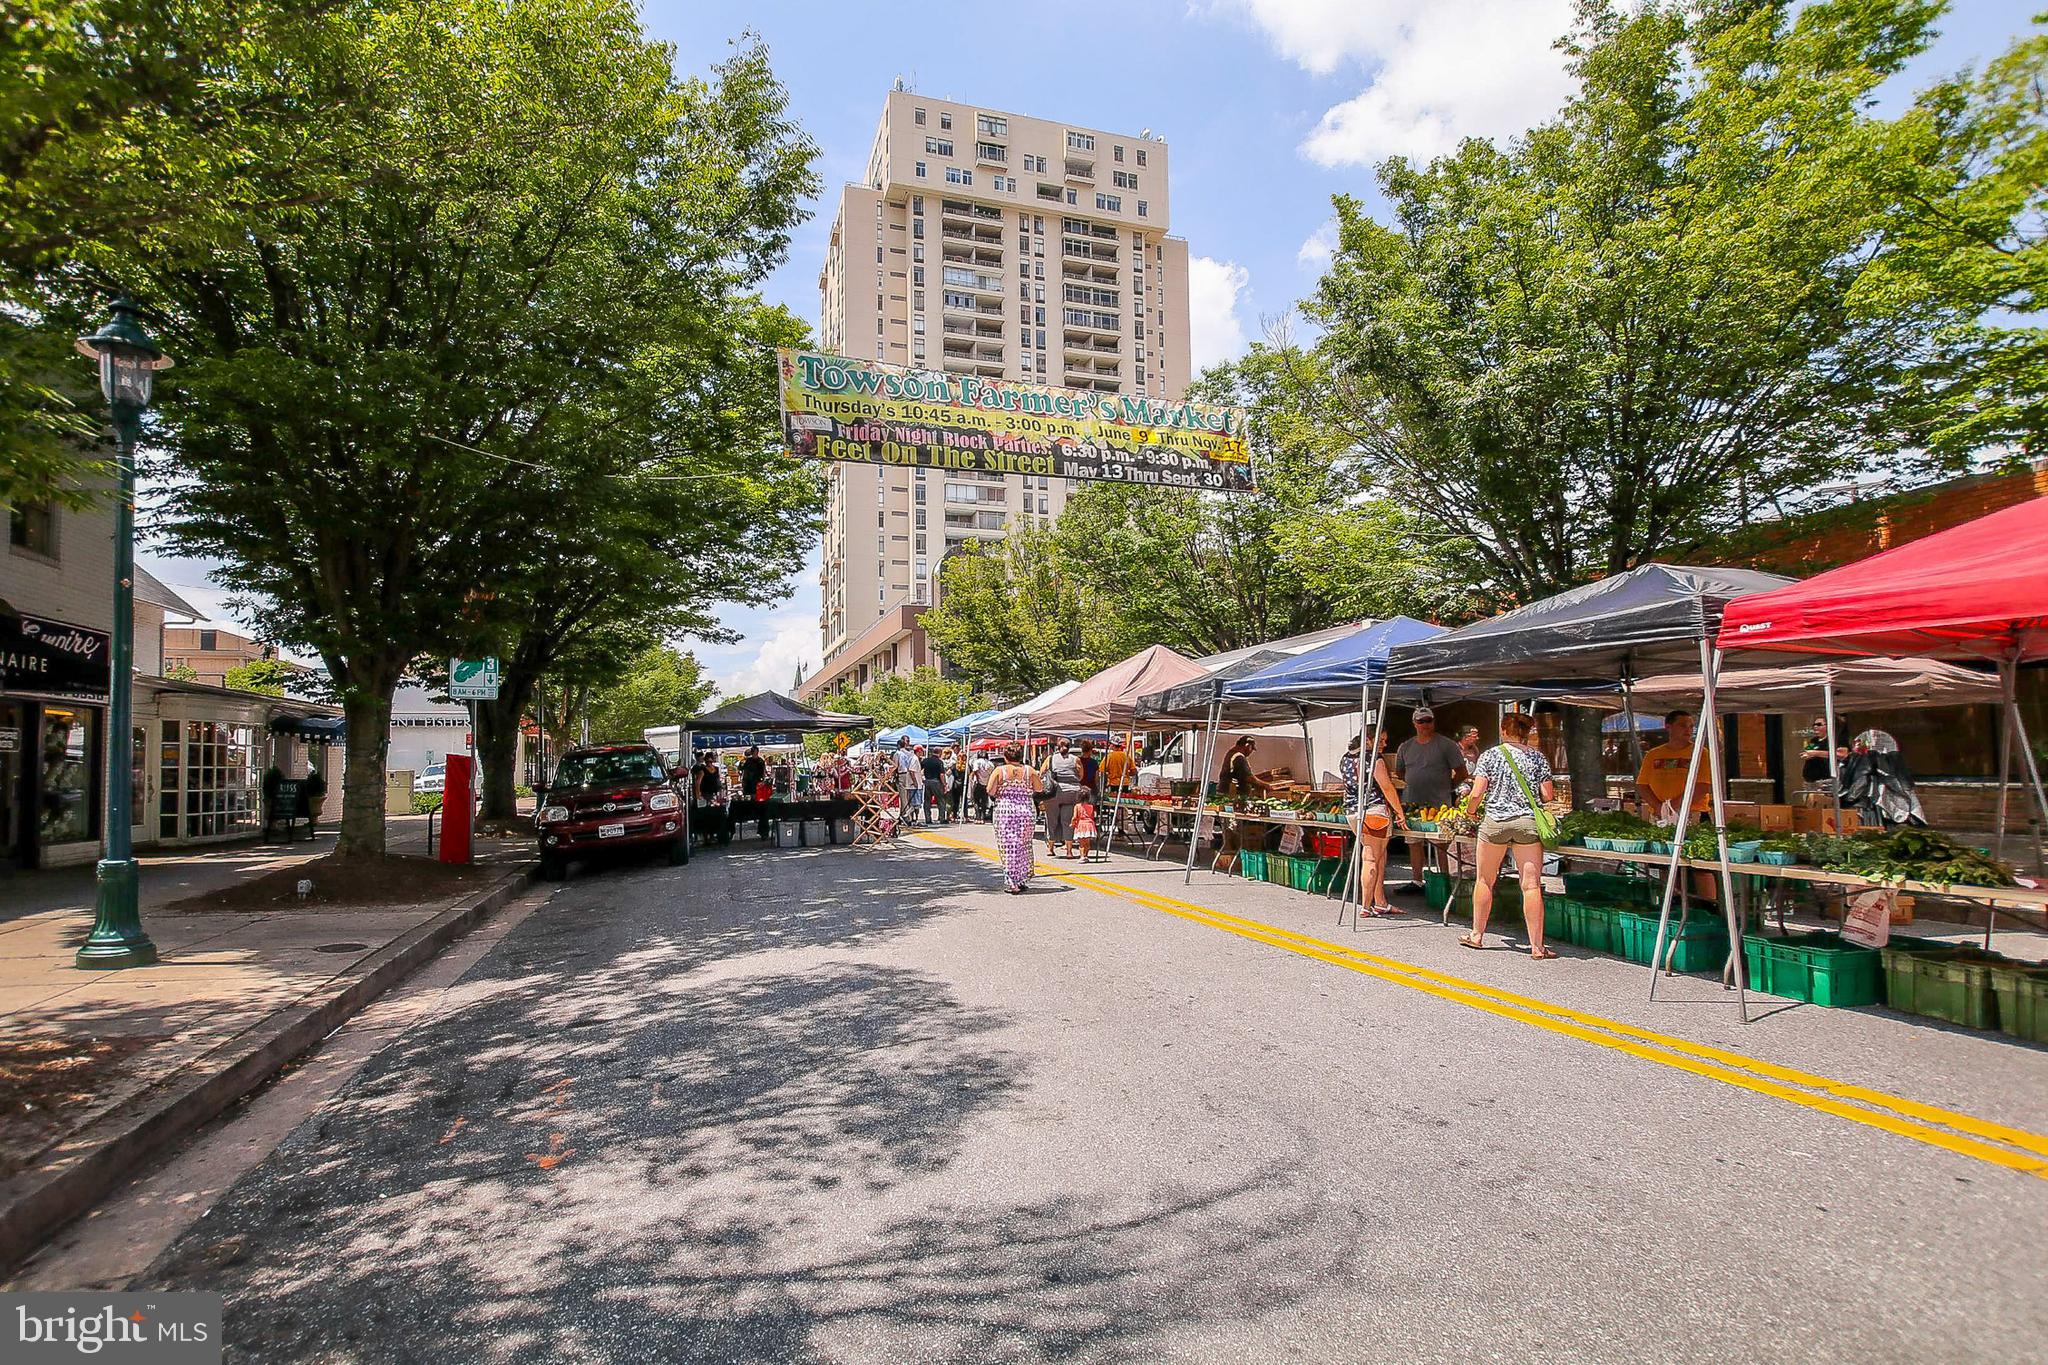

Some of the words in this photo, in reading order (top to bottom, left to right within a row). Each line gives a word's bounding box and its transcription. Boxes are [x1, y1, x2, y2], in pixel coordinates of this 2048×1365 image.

[797, 354, 951, 402] Towson
[960, 376, 1117, 420] Farmer's
[1121, 395, 1237, 434] Market
[802, 394, 895, 418] Thursday's
[901, 404, 951, 423] 10:45
[957, 412, 992, 428] a.m.
[1006, 416, 1042, 432] 3:00
[1047, 423, 1080, 438] p.m.
[1098, 426, 1131, 441] June
[1138, 430, 1149, 443] 9
[1156, 432, 1189, 446] Thru
[1223, 440, 1242, 454] 17
[837, 423, 890, 443] Friday
[895, 425, 938, 445] Night
[943, 430, 988, 449] Block
[815, 434, 873, 462] Feet
[881, 440, 918, 465] On
[926, 443, 976, 469] The
[983, 448, 1056, 475] Street
[1061, 443, 1097, 459] 6:30
[1101, 449, 1136, 462] p.m.
[1145, 450, 1179, 466] 9:30
[1063, 461, 1098, 478] May
[1101, 463, 1124, 479] 13
[1124, 466, 1160, 485] Thru
[1203, 472, 1224, 487] 30
[486, 658, 495, 670] 3
